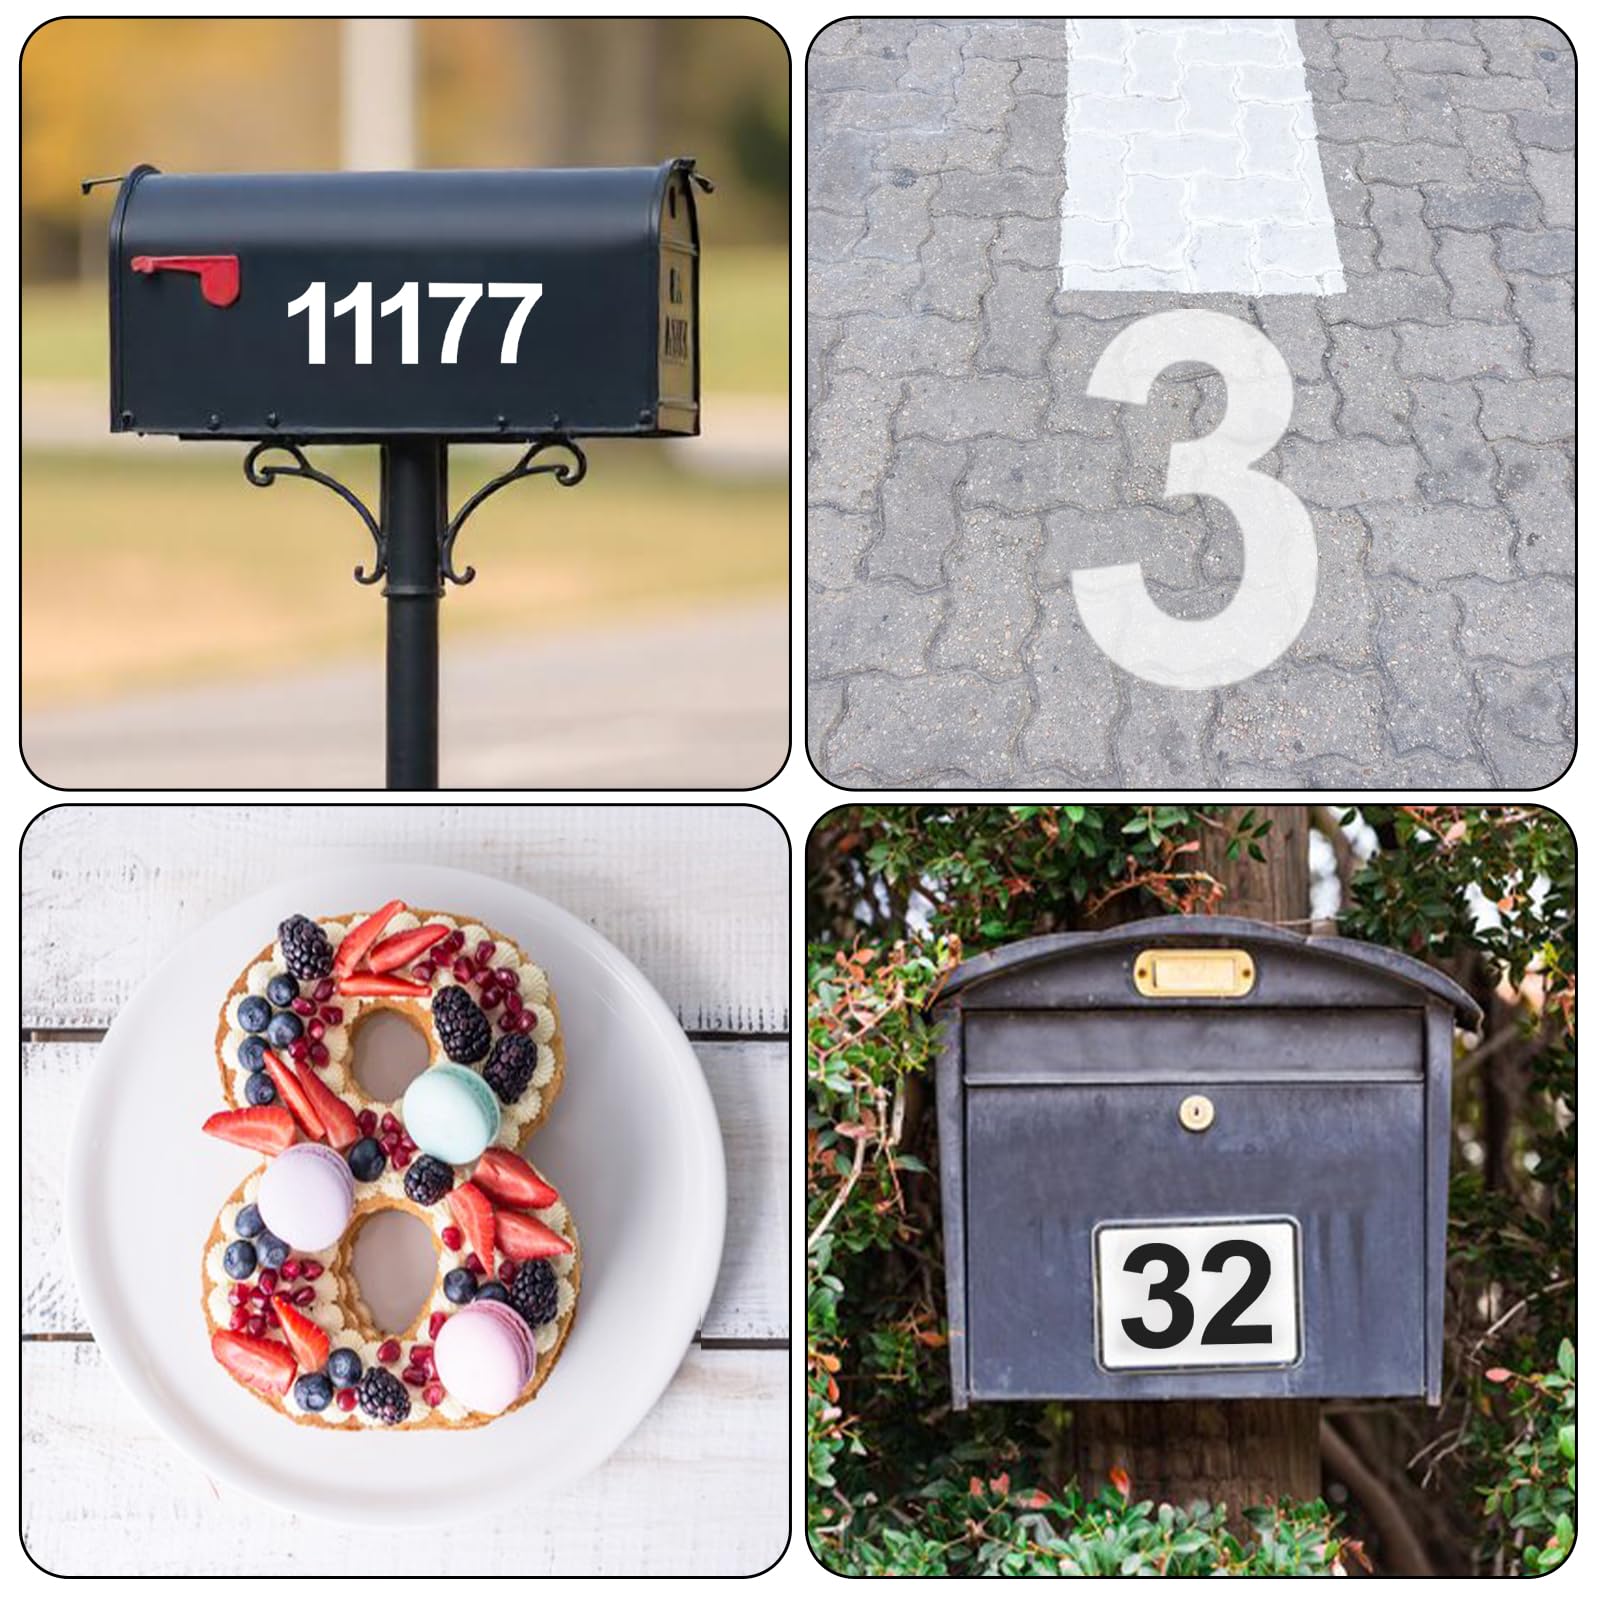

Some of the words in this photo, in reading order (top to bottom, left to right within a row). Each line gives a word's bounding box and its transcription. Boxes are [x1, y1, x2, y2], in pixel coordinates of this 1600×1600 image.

[288, 282, 543, 364] 11177
[1071, 308, 1319, 691] 3
[201, 908, 582, 1430] 8
[1121, 1240, 1273, 1349] 32
